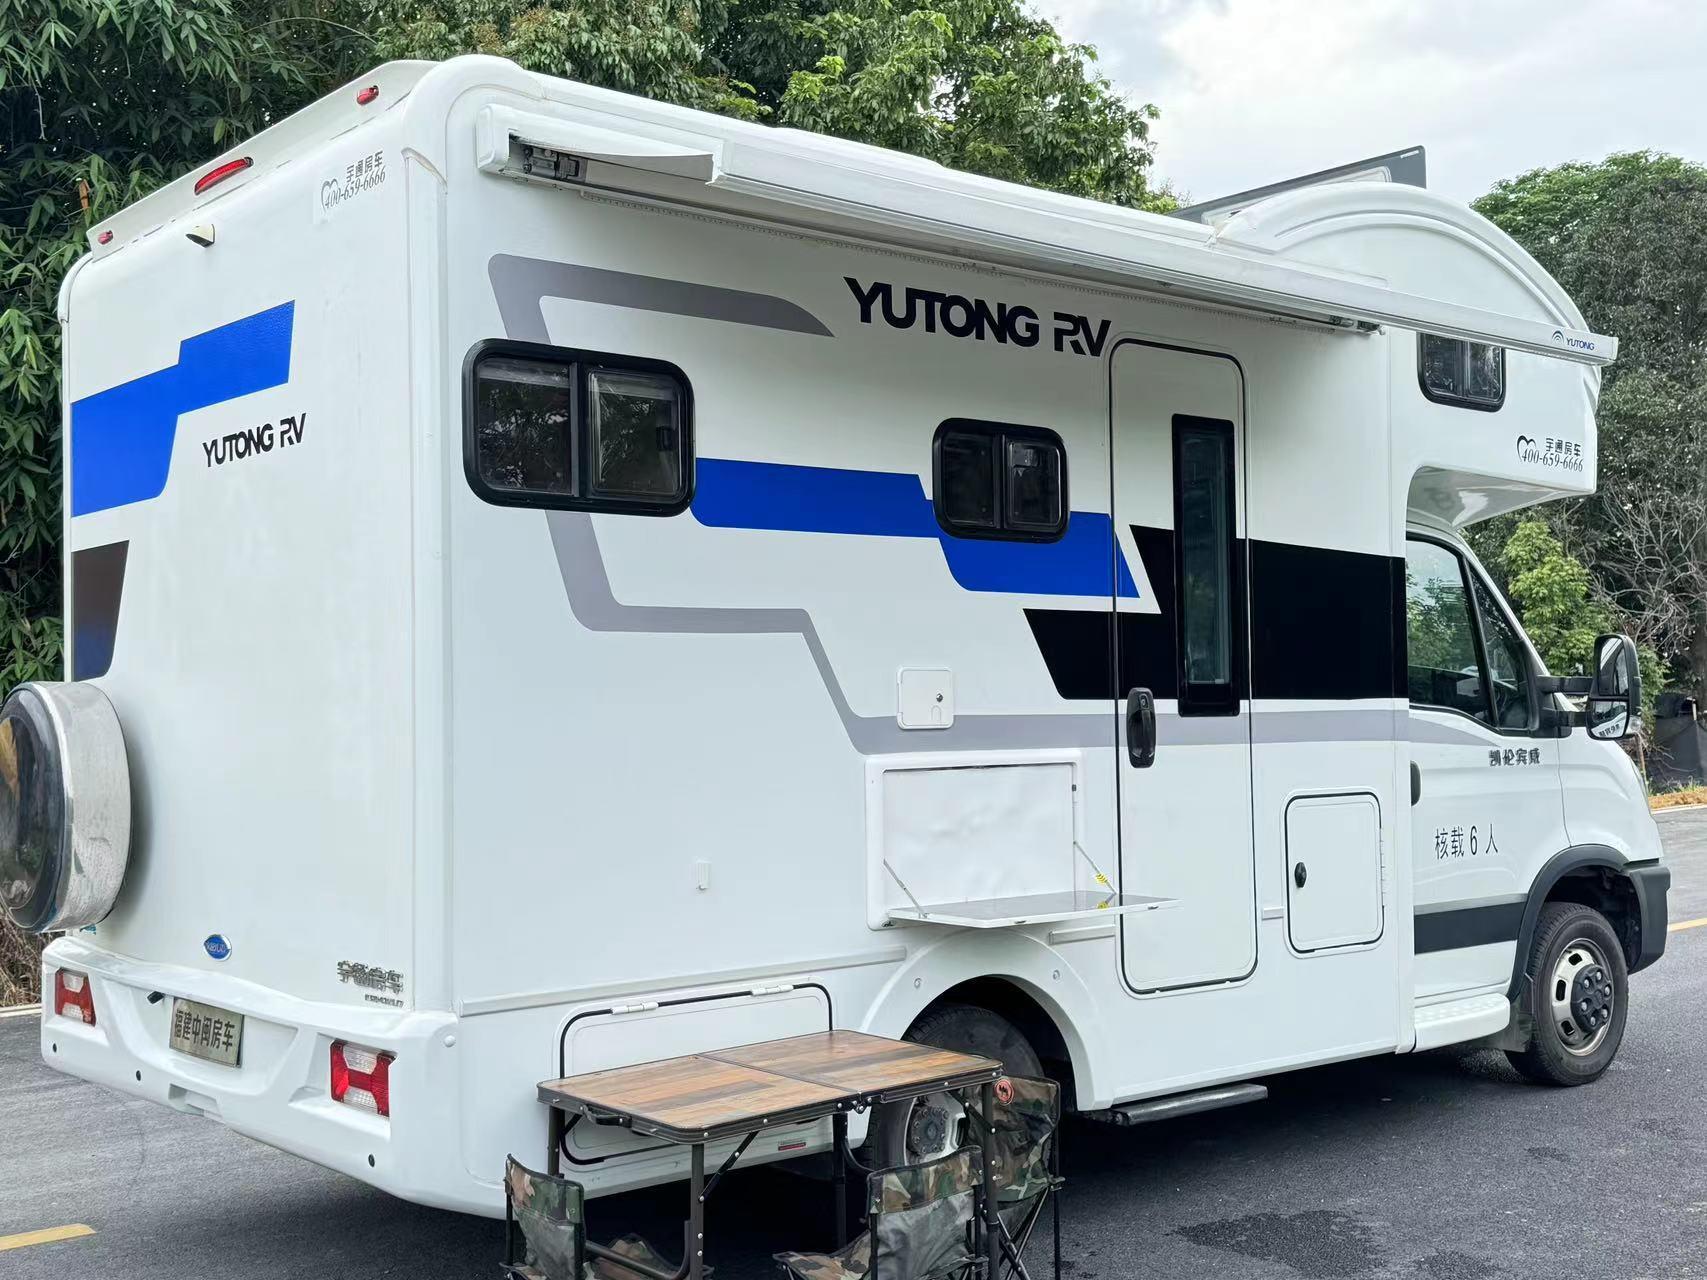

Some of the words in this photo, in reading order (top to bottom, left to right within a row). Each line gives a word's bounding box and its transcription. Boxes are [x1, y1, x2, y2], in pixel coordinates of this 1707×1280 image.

[346, 150, 383, 183] 宇通房车
[325, 165, 386, 209] 400-659-6666
[843, 276, 1040, 347] YUTONG
[1053, 311, 1112, 357] RV
[1566, 337, 1595, 351] YUTONG
[202, 423, 274, 468] YUTONG
[280, 412, 307, 448] RV
[1545, 437, 1581, 457] 宇通房车
[1521, 448, 1584, 473] 400-659-6666
[175, 1008, 235, 1052] 福建中闽房车
